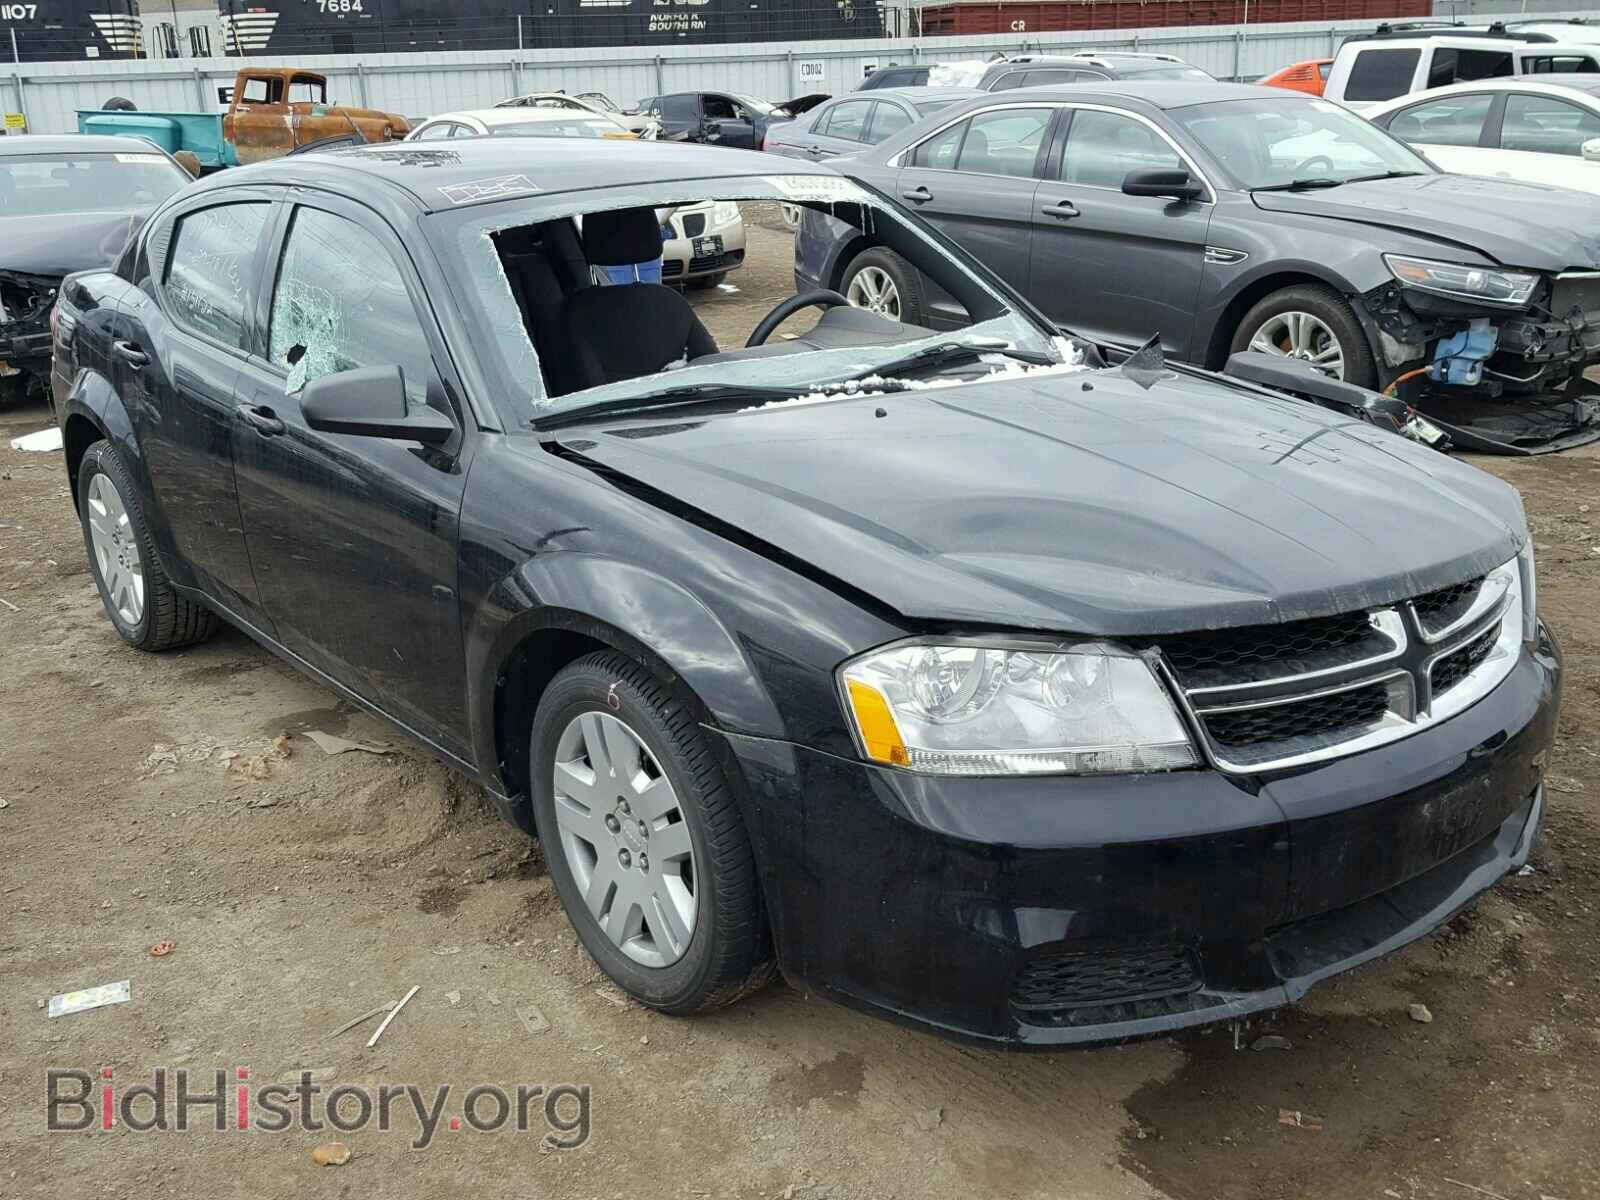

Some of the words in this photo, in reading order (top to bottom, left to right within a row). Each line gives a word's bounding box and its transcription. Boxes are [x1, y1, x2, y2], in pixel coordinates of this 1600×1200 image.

[1, 4, 37, 19] 1107
[316, 0, 363, 12] 7684
[1011, 20, 1025, 31] CR
